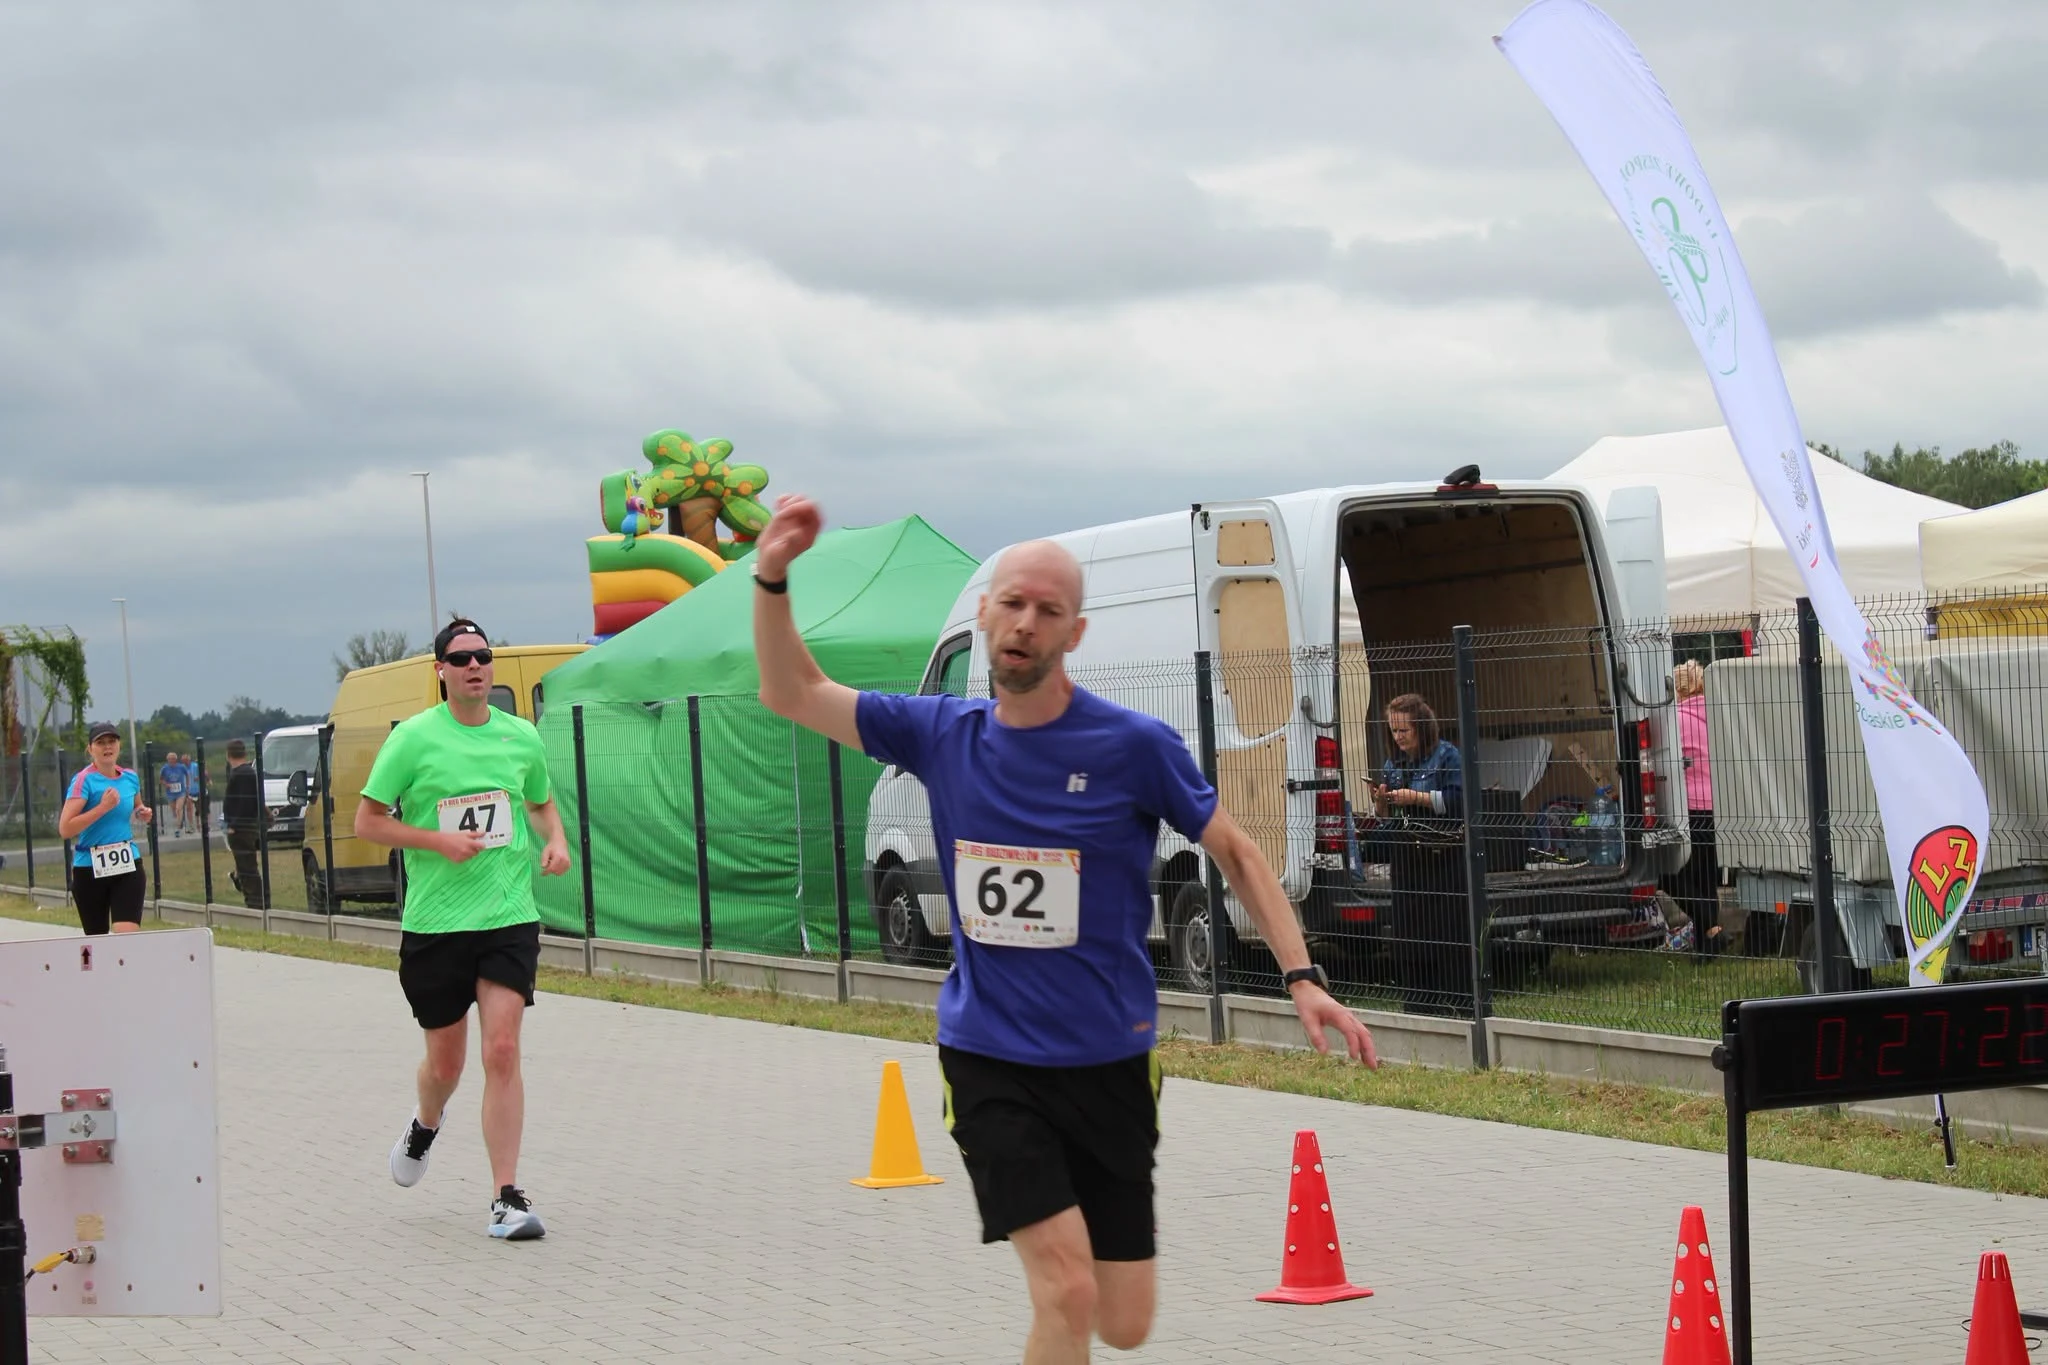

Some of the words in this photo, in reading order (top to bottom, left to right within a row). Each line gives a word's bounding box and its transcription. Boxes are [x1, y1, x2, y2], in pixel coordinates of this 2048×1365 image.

[459, 803, 496, 832] 47
[97, 848, 130, 868] 190
[978, 866, 1045, 919] 62
